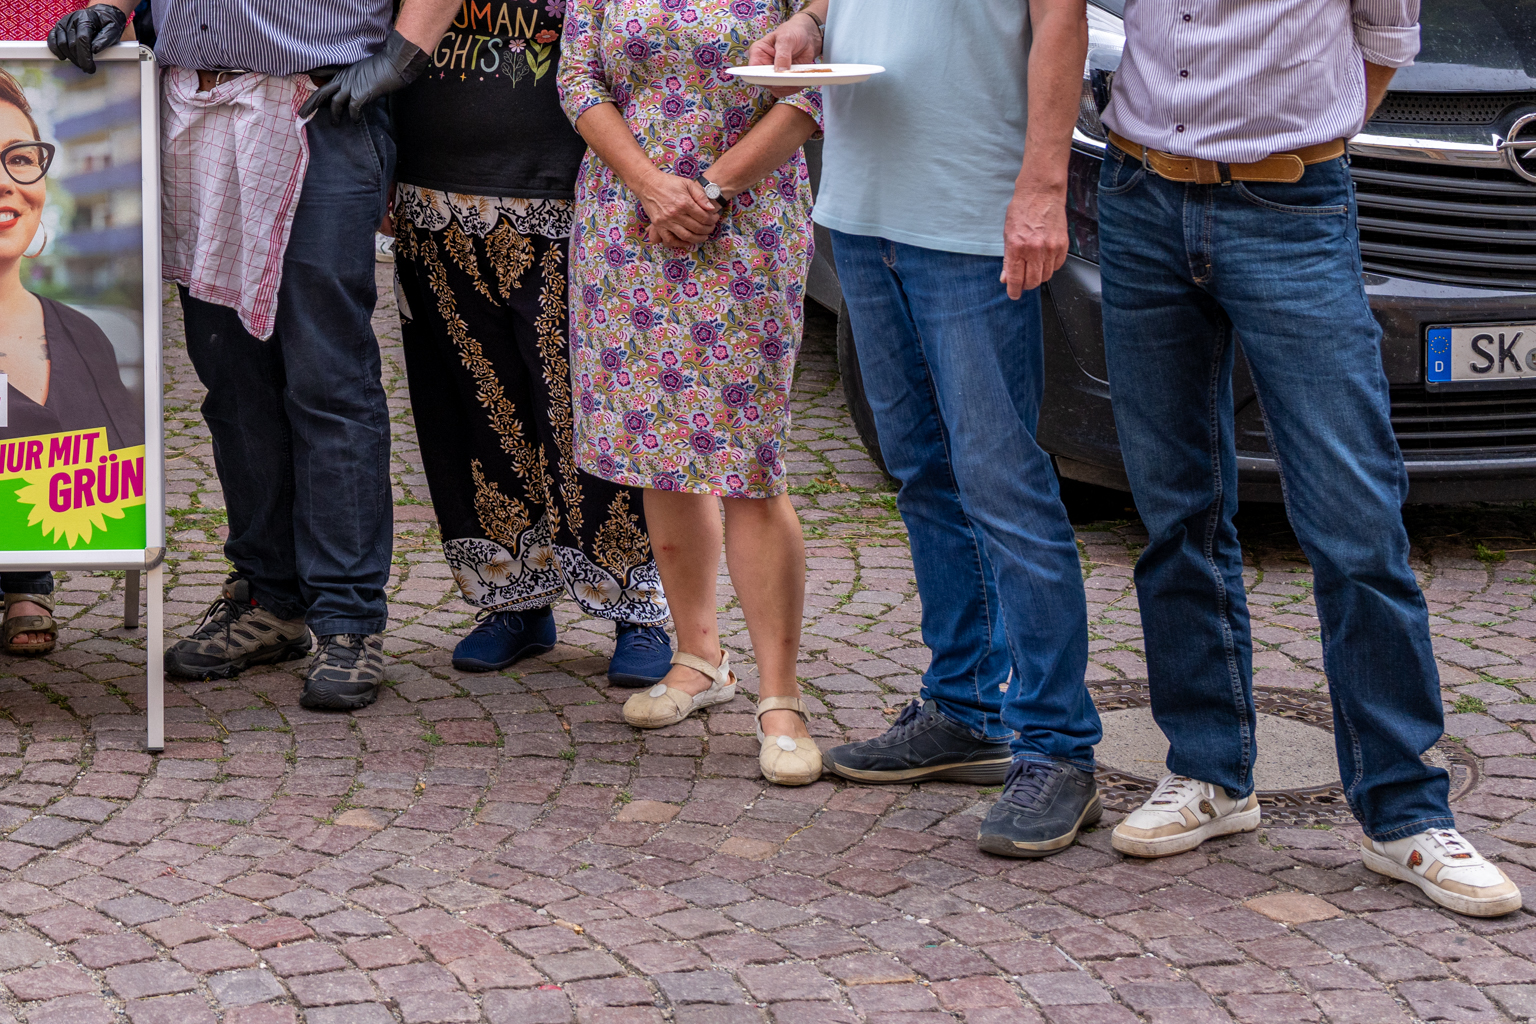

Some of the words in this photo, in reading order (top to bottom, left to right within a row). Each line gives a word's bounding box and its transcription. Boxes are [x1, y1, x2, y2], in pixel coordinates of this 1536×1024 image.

[448, 0, 538, 39] UMAN
[433, 31, 503, 73] GHTS
[1434, 361, 1444, 373] D
[1469, 331, 1524, 374] SK
[48, 431, 100, 469] MIT
